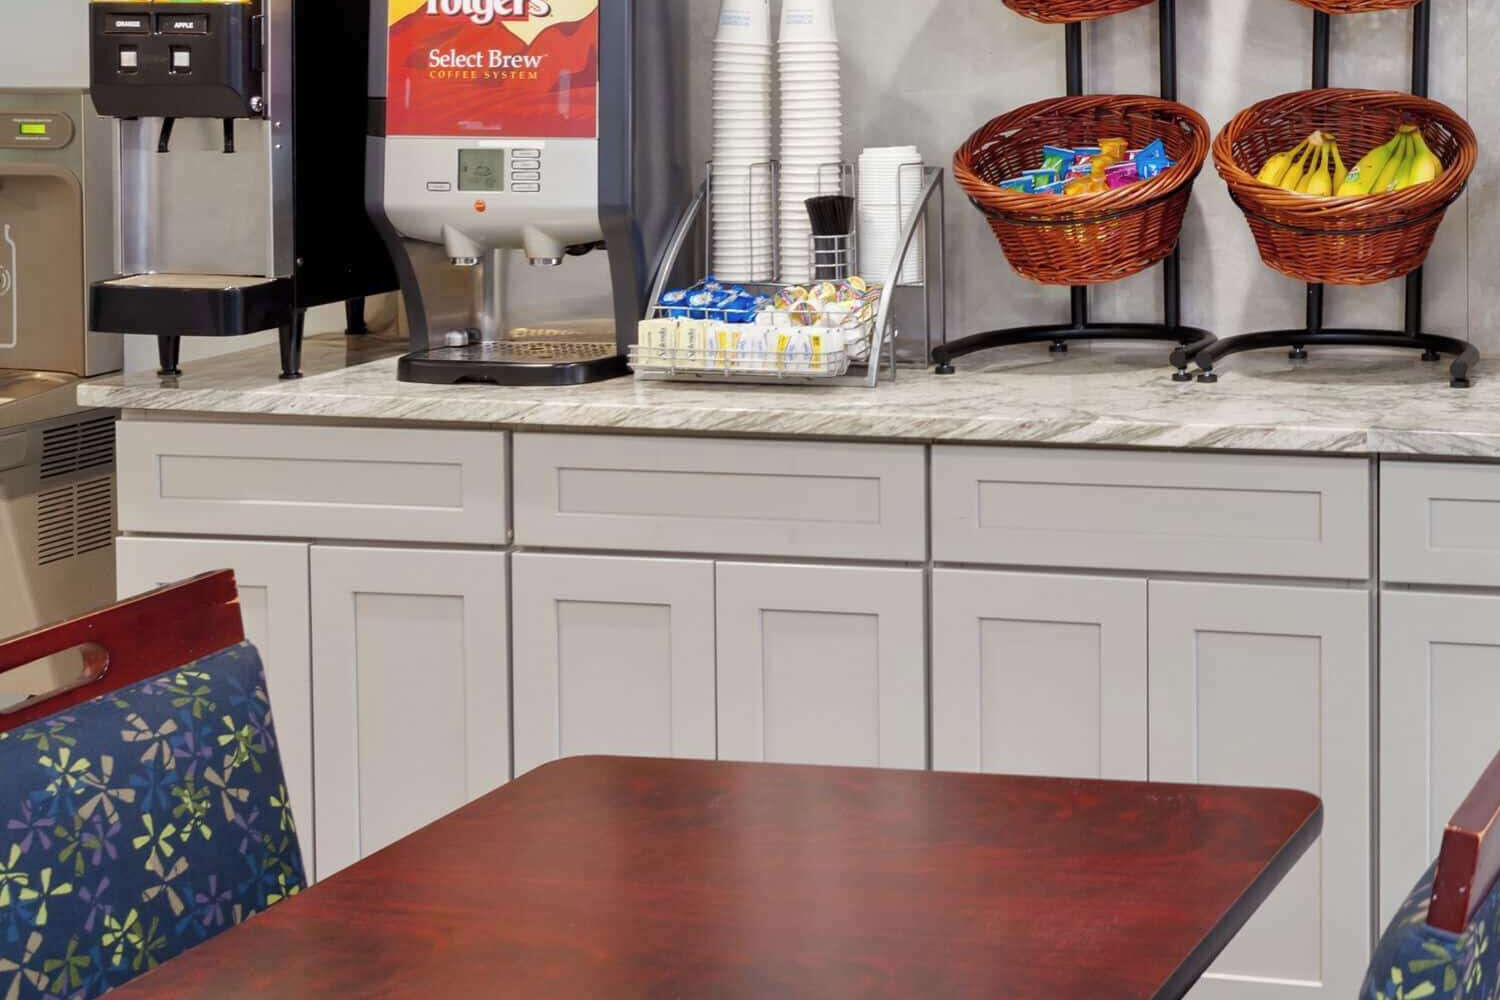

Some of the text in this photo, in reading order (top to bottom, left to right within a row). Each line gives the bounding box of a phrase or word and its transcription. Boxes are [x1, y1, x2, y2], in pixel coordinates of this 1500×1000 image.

[429, 49, 542, 68] Select Brew
[430, 71, 537, 79] COFFEE SYSTEM
